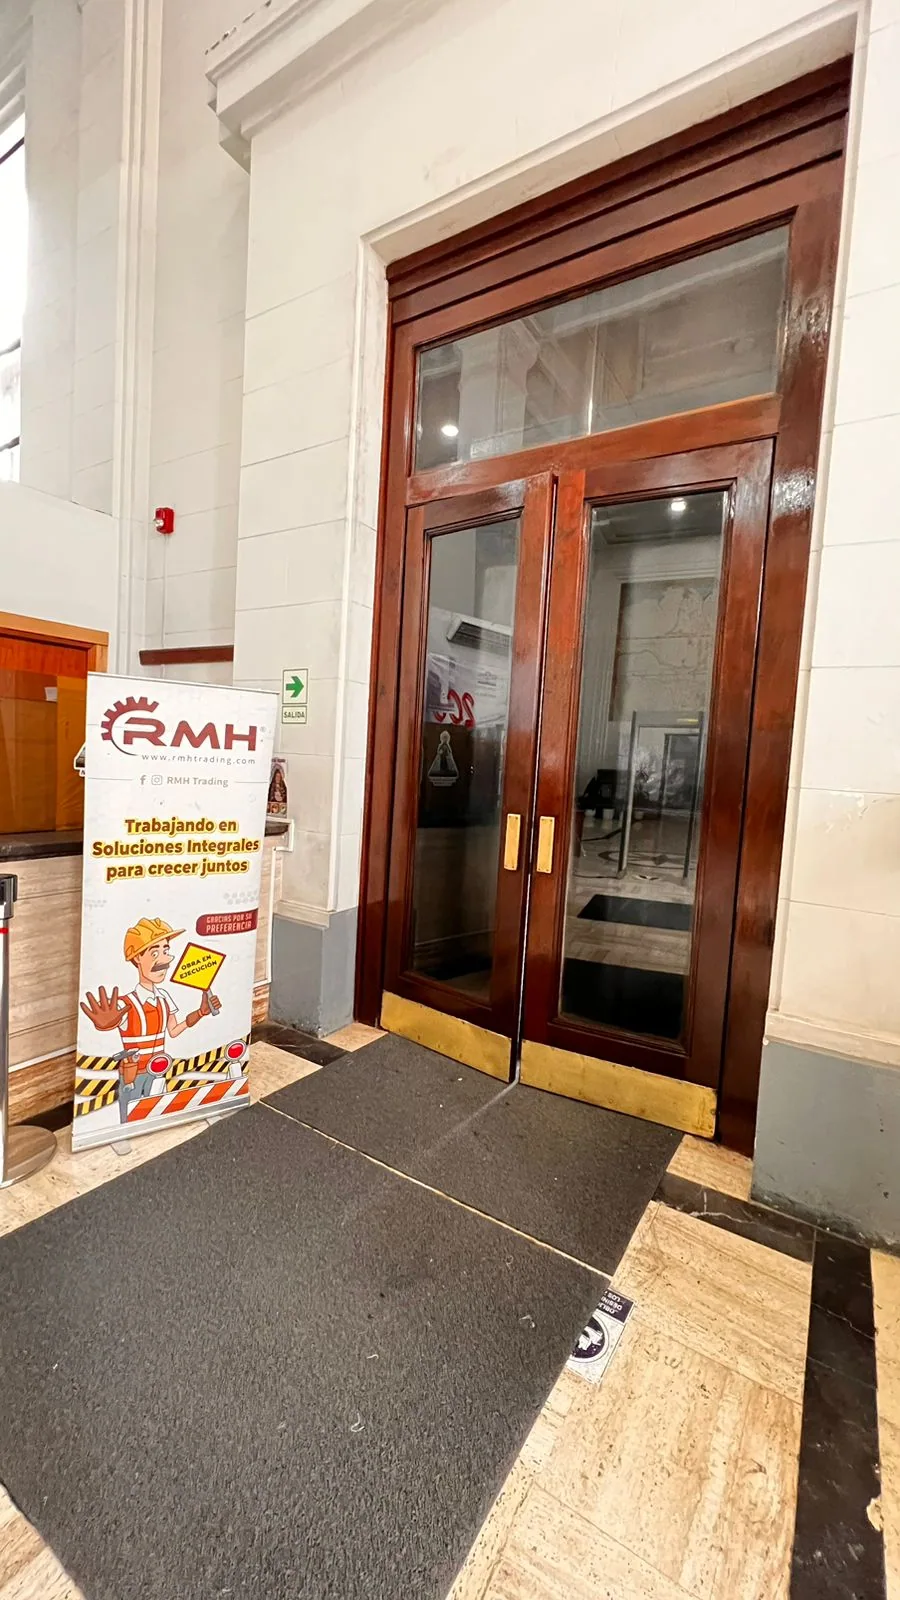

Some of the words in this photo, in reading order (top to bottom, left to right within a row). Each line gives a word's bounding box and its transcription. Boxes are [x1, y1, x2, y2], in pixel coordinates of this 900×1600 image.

[283, 711, 305, 719] SALIDA
[123, 717, 258, 751] RMH
[141, 754, 256, 766] www.rmhtrading.com
[166, 776, 190, 785] RMH
[192, 777, 229, 787] Trading
[125, 816, 215, 836] Trabajando
[218, 819, 237, 832] en
[92, 838, 183, 857] Soluciones
[187, 838, 260, 856] Integrales
[106, 865, 144, 881] para
[148, 862, 199, 877] crecer
[200, 858, 249, 877] juntos
[206, 921, 252, 933] PREFERENCIA
[180, 960, 217, 979] EJECUCIÓN
[181, 960, 201, 970] OBRA
[598, 1302, 615, 1314] OBLI
